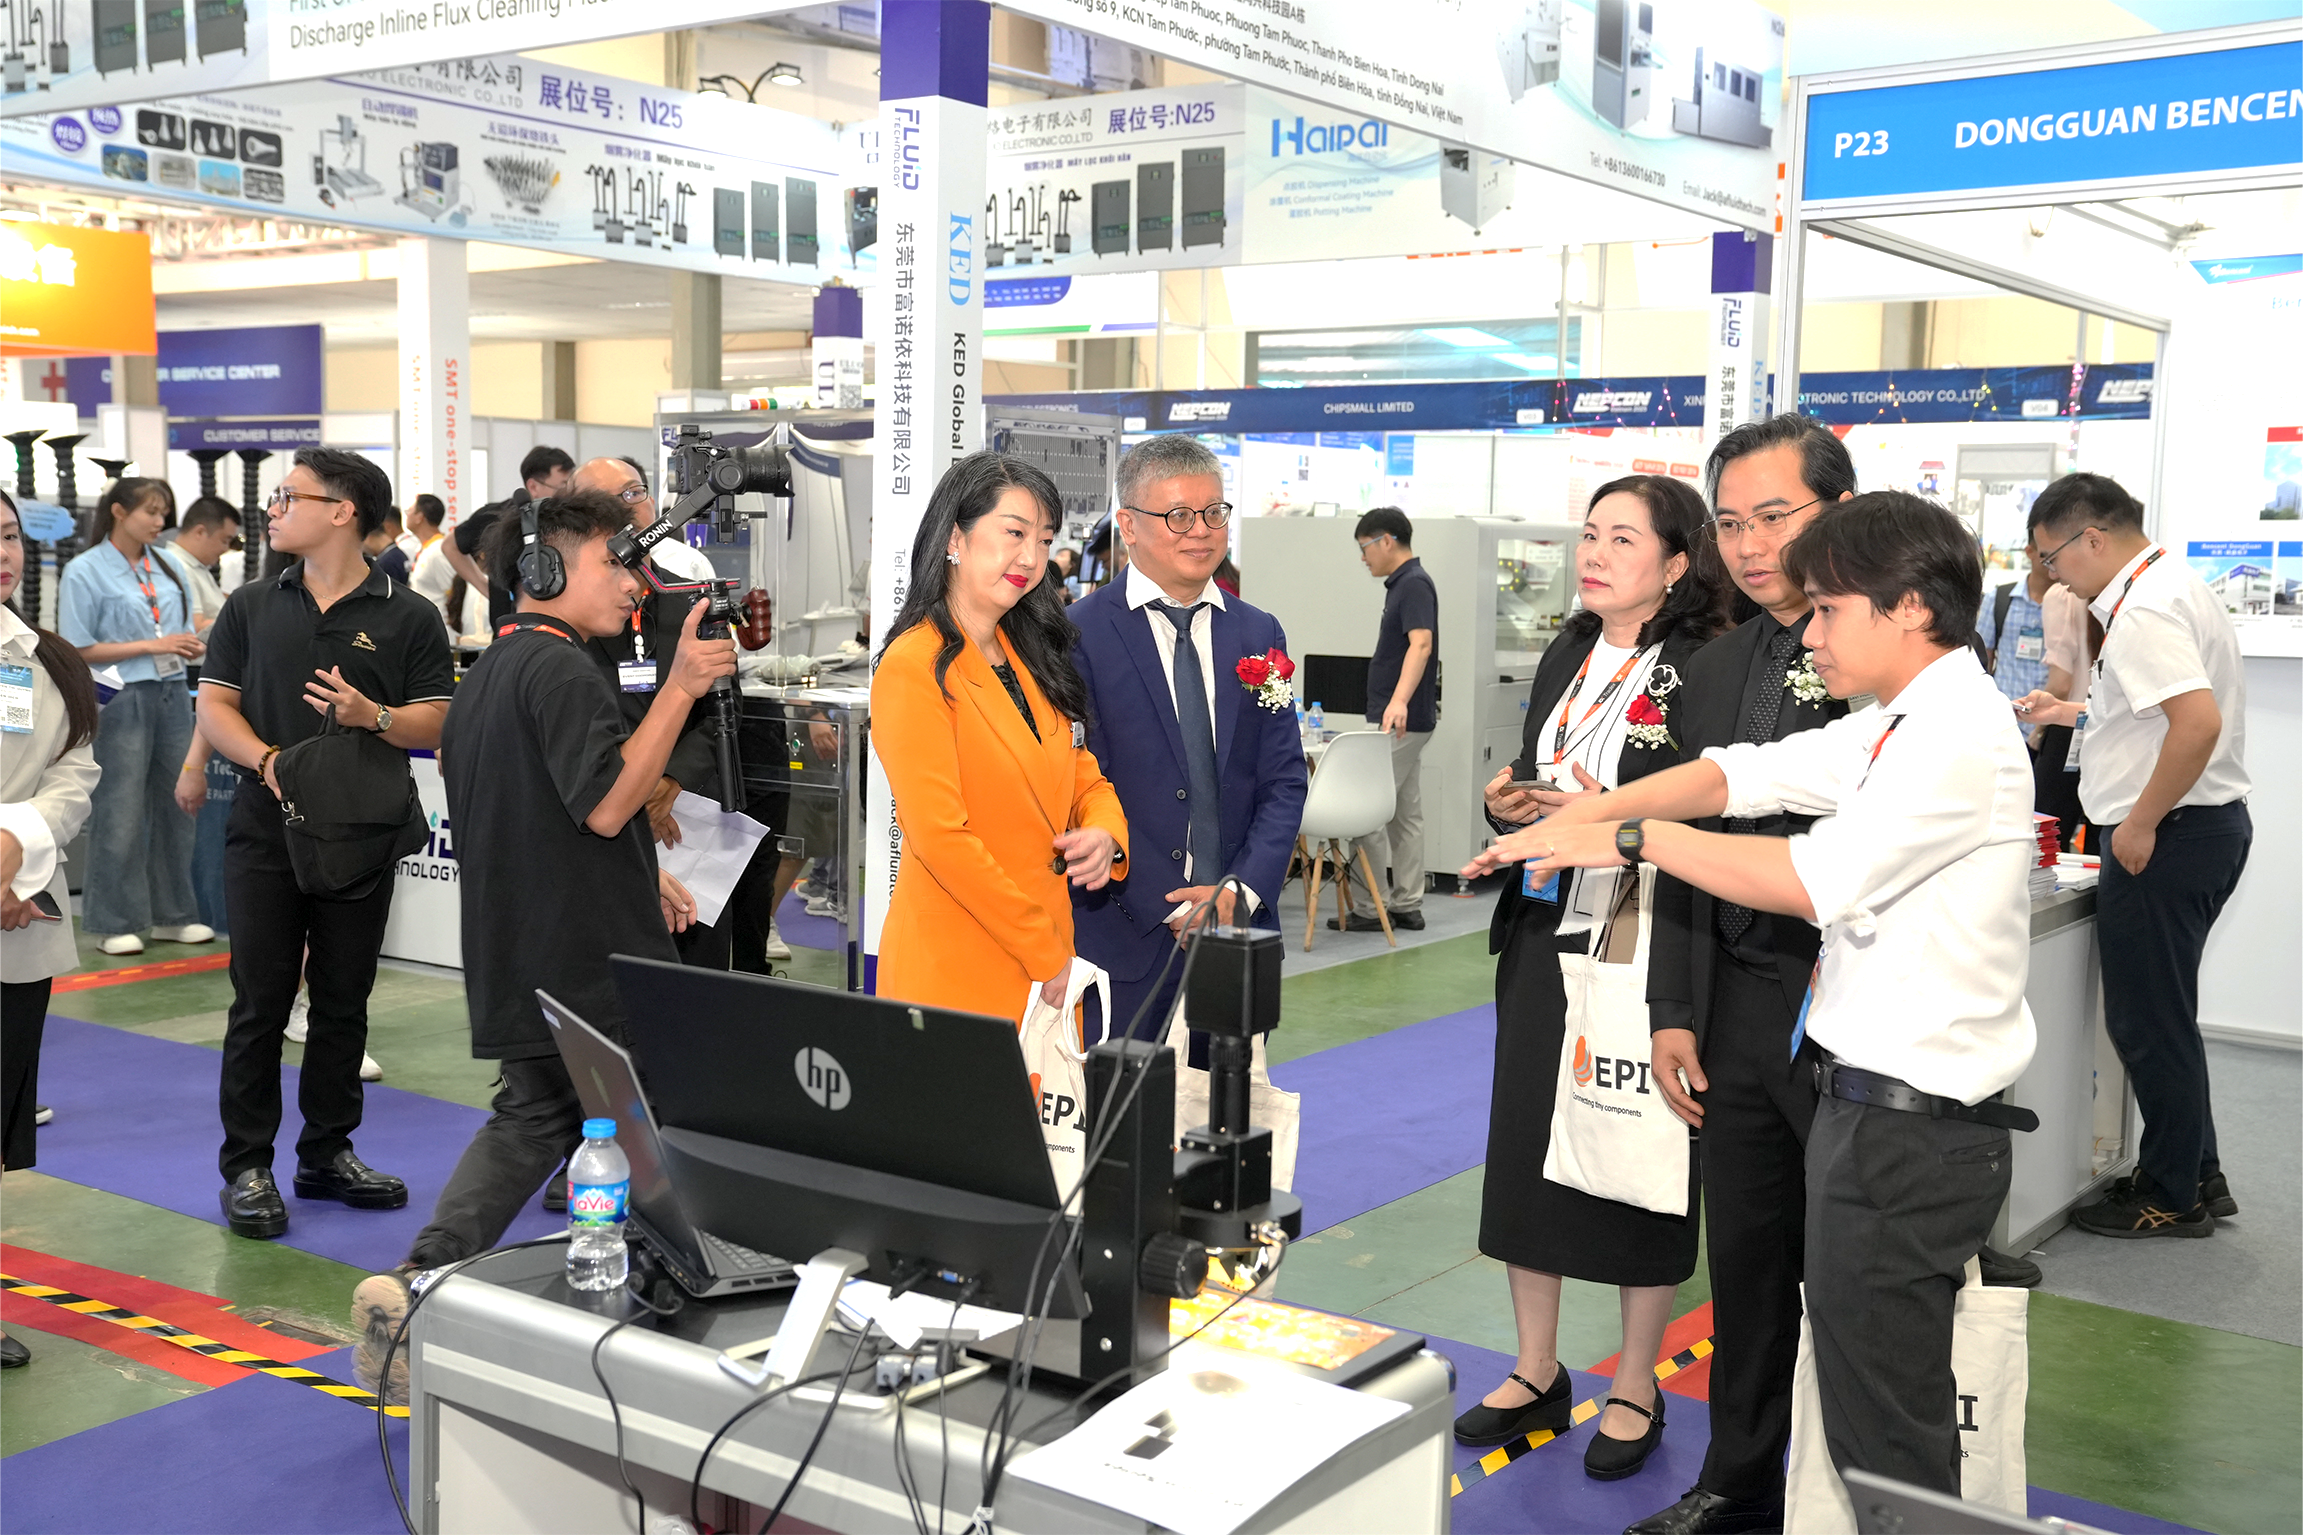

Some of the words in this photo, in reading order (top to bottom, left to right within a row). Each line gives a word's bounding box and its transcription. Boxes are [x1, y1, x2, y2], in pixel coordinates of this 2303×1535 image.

[290, 20, 375, 49] Discharge
[380, 9, 428, 36] Inline
[433, 1, 471, 28] Flux
[1122, 5, 1144, 25] KCN
[1146, 13, 1166, 32] Tam
[1242, 44, 1261, 62] Tam
[1262, 23, 1280, 42] Tam
[640, 97, 684, 130] N25
[1834, 130, 1890, 159] P23
[1954, 102, 2158, 150] DONGGUAN
[949, 210, 972, 306] KED
[891, 222, 915, 495] 东莞市富诺依科技有限公司
[953, 332, 966, 377] KED
[172, 366, 226, 382] SERVICE
[228, 364, 281, 380] CENTER
[445, 358, 459, 400] SMT
[2097, 379, 2153, 403] NEP
[1169, 402, 1231, 420] NEPCON
[1323, 402, 1375, 414] CHIPSMALL
[1377, 401, 1414, 413] LIMITED
[1573, 391, 1652, 412] NEPCON
[1718, 366, 1736, 440] 东莞市富诺
[1851, 389, 1935, 404] TECHNOLOGY
[951, 384, 965, 450] Global
[203, 429, 269, 442] CUSTOMER
[444, 404, 458, 490] one-stop
[638, 517, 673, 549] RONIN
[894, 548, 906, 572] Tel:
[806, 1047, 841, 1109] hp
[1595, 1055, 1651, 1095] EPI
[1572, 1091, 1595, 1109] Connecting
[1595, 1101, 1604, 1111] tiny
[1604, 1104, 1643, 1118] components
